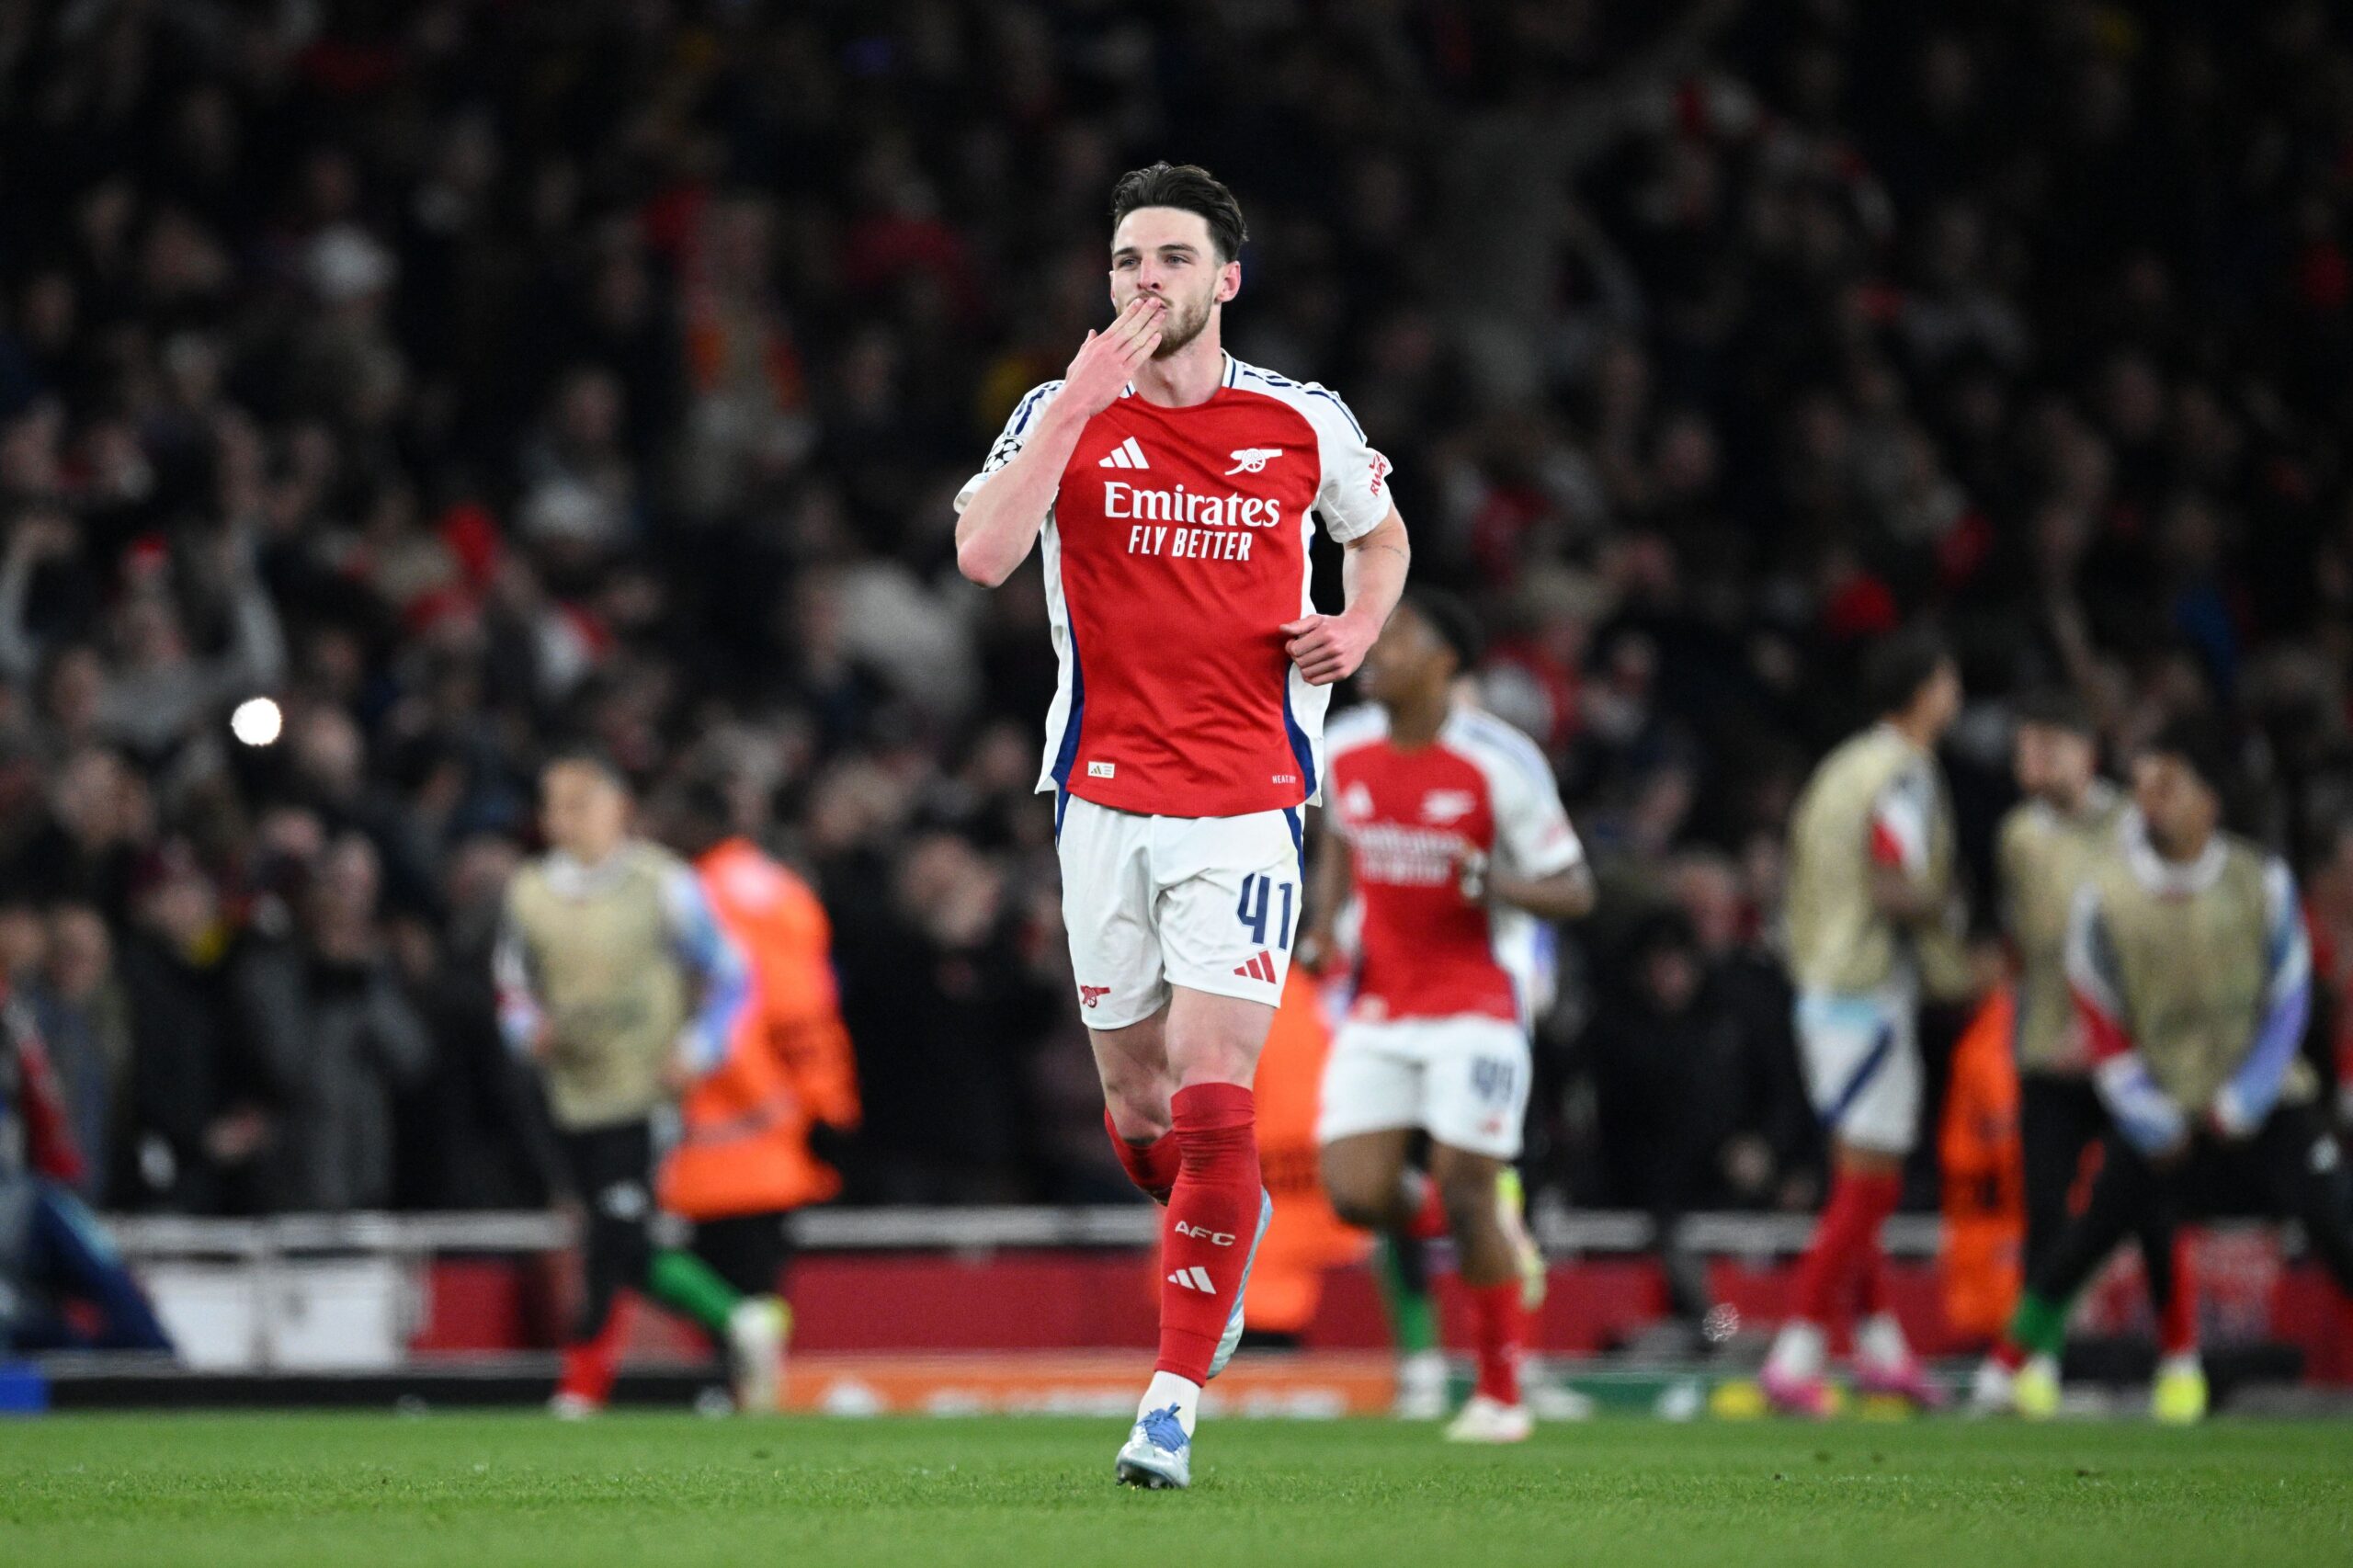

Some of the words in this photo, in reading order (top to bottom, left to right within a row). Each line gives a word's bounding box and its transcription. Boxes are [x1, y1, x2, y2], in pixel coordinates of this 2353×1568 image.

[1103, 481, 1280, 528] Emirates
[1128, 525, 1168, 556] FLY
[1171, 527, 1253, 562] BETTER
[1236, 871, 1294, 951] 41
[1175, 1220, 1236, 1246] AFC
